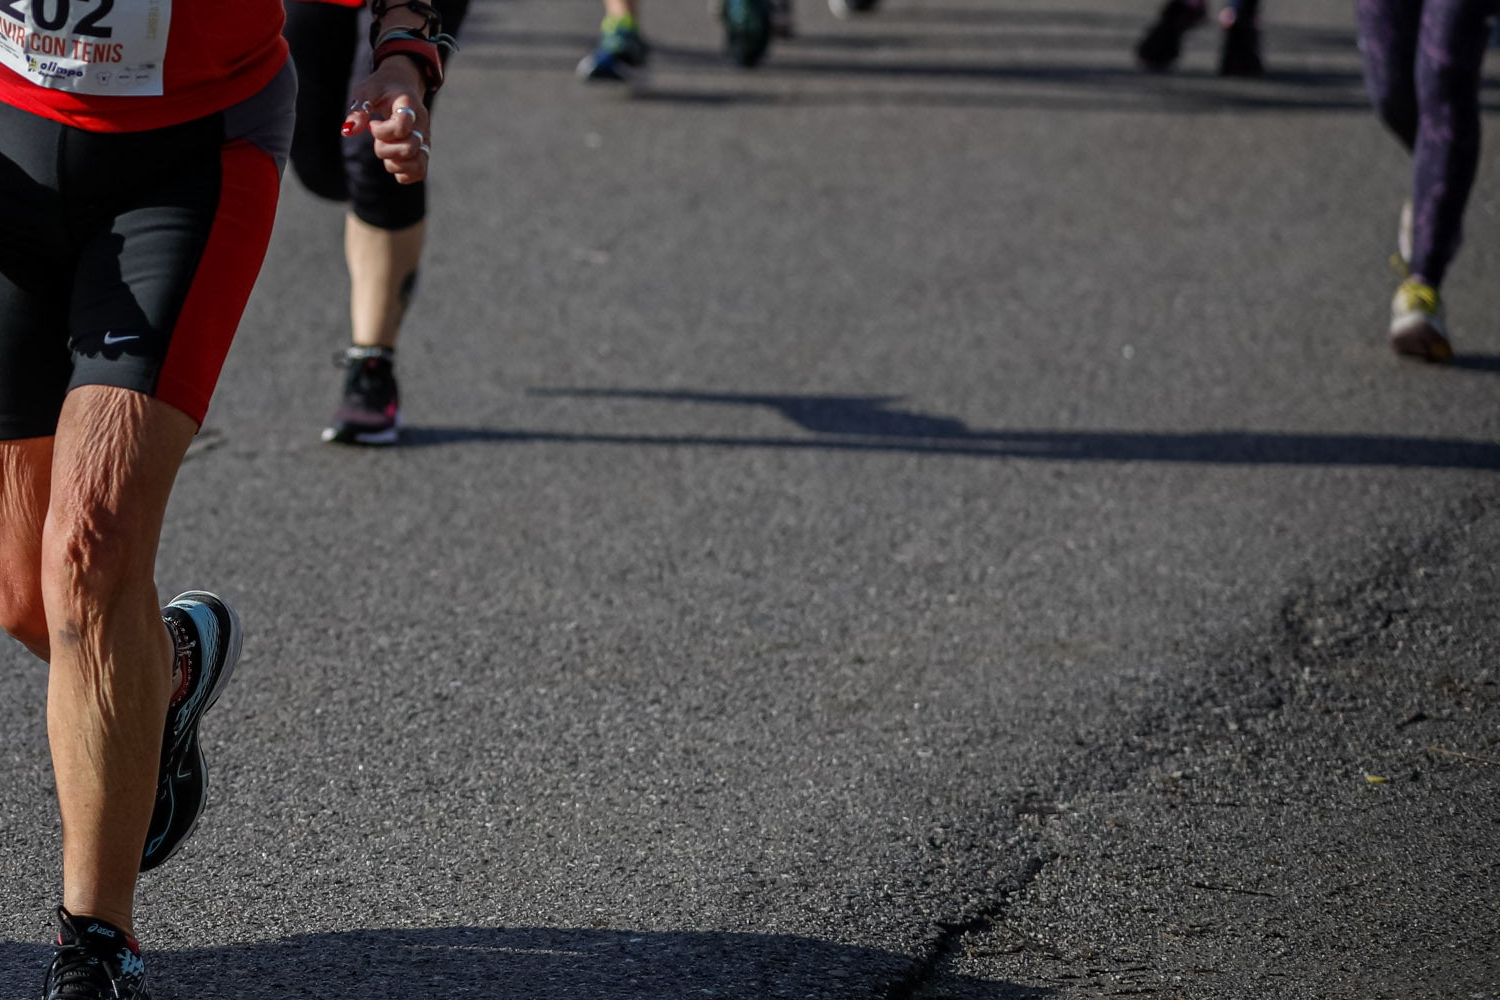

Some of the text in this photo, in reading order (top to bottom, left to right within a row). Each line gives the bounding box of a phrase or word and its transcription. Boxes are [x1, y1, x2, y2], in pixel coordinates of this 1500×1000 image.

[30, 32, 66, 57] CON
[72, 39, 123, 64] TENIS
[40, 61, 83, 77] olimpo
